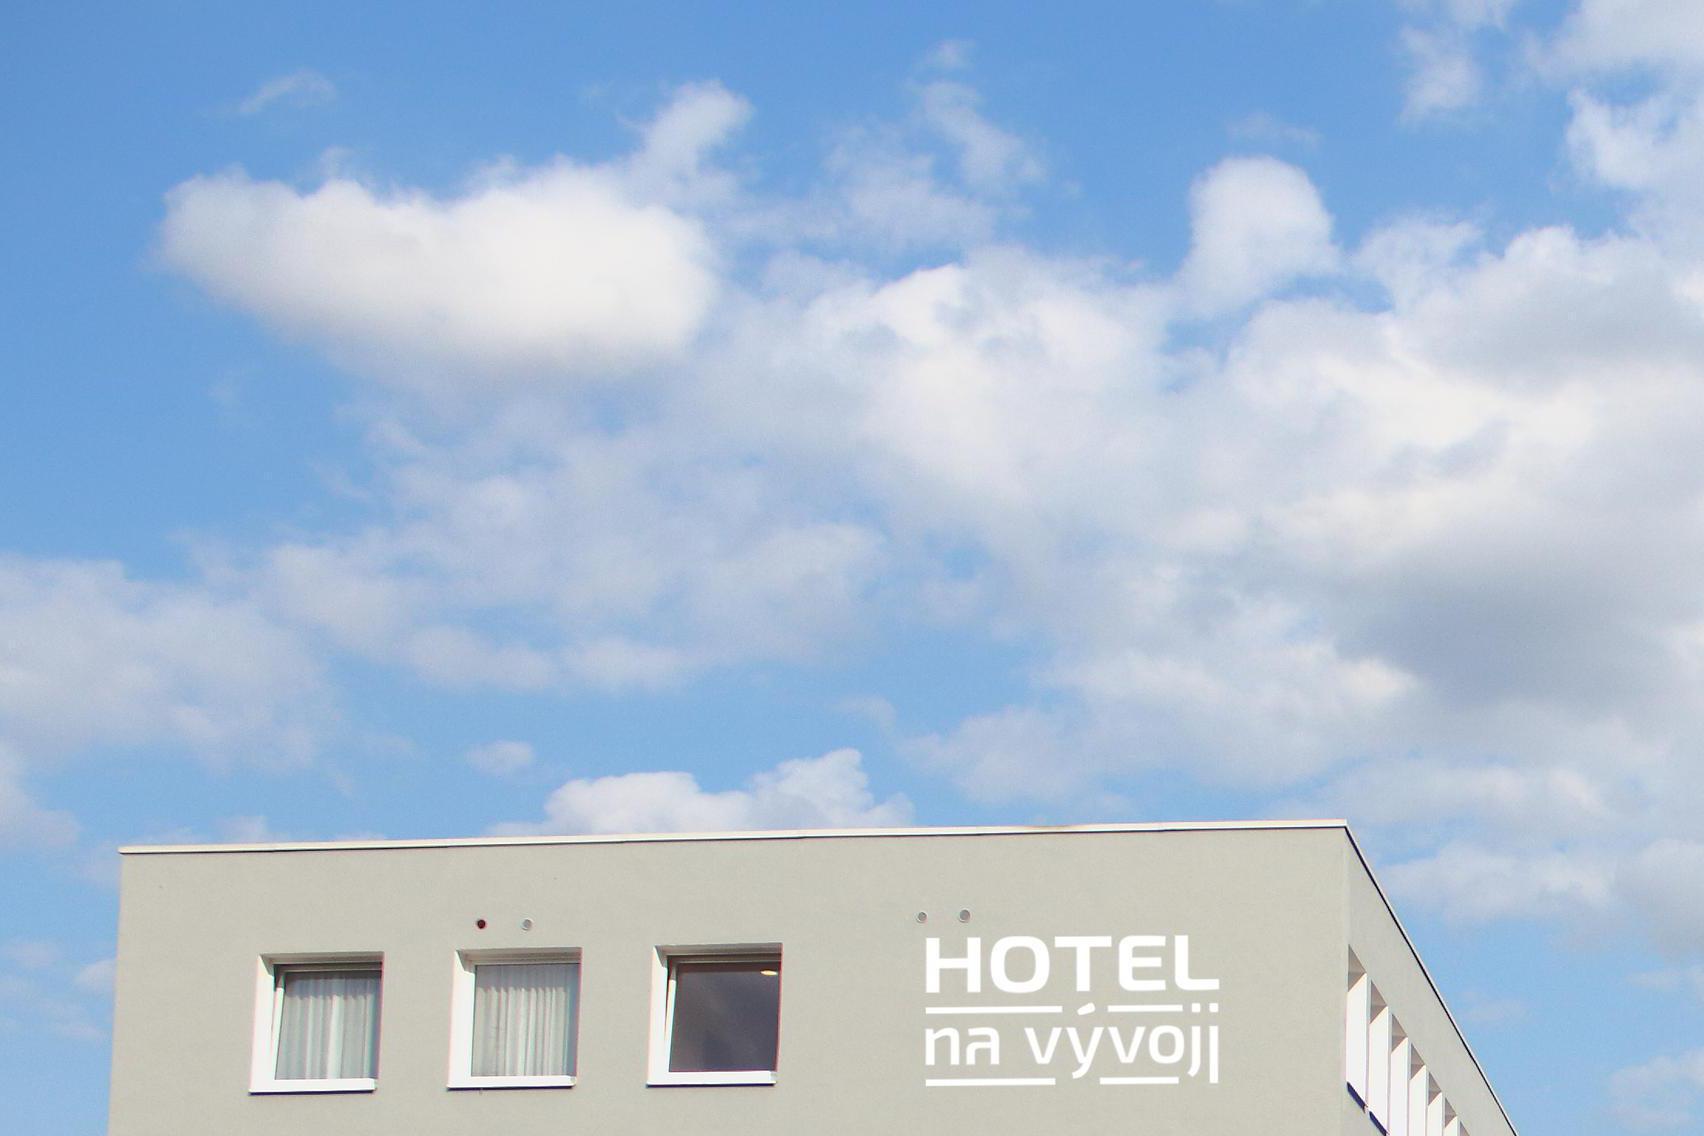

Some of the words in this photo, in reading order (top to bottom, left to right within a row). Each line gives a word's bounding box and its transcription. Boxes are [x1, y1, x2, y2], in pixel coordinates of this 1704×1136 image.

[925, 934, 1220, 994] HOTEL
[924, 1026, 1000, 1066] na
[1023, 1001, 1220, 1085] vývoji
